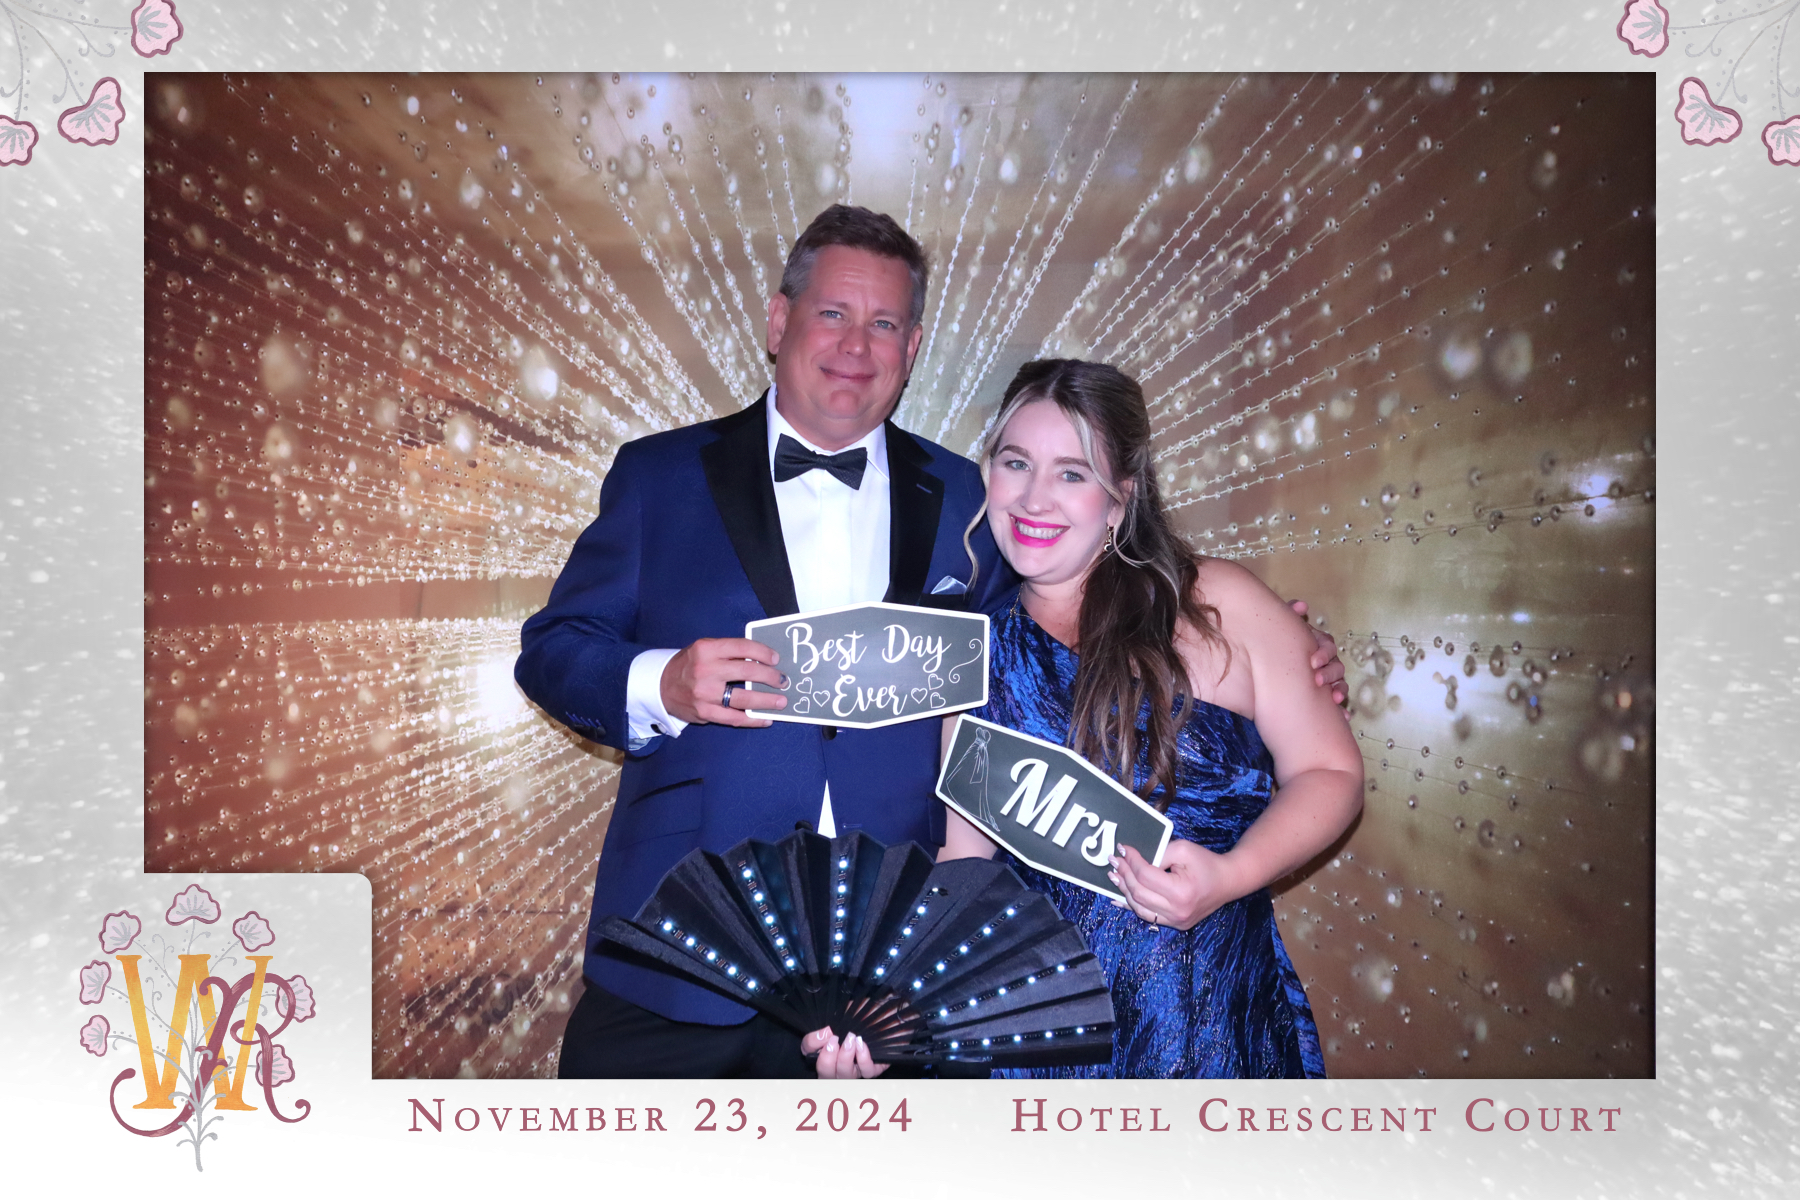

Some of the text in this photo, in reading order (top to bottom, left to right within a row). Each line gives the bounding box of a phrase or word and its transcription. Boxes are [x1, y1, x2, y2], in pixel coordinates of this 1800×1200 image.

[785, 623, 952, 674] Best Day
[832, 673, 908, 717] Ever
[1000, 758, 1118, 872] Mrs
